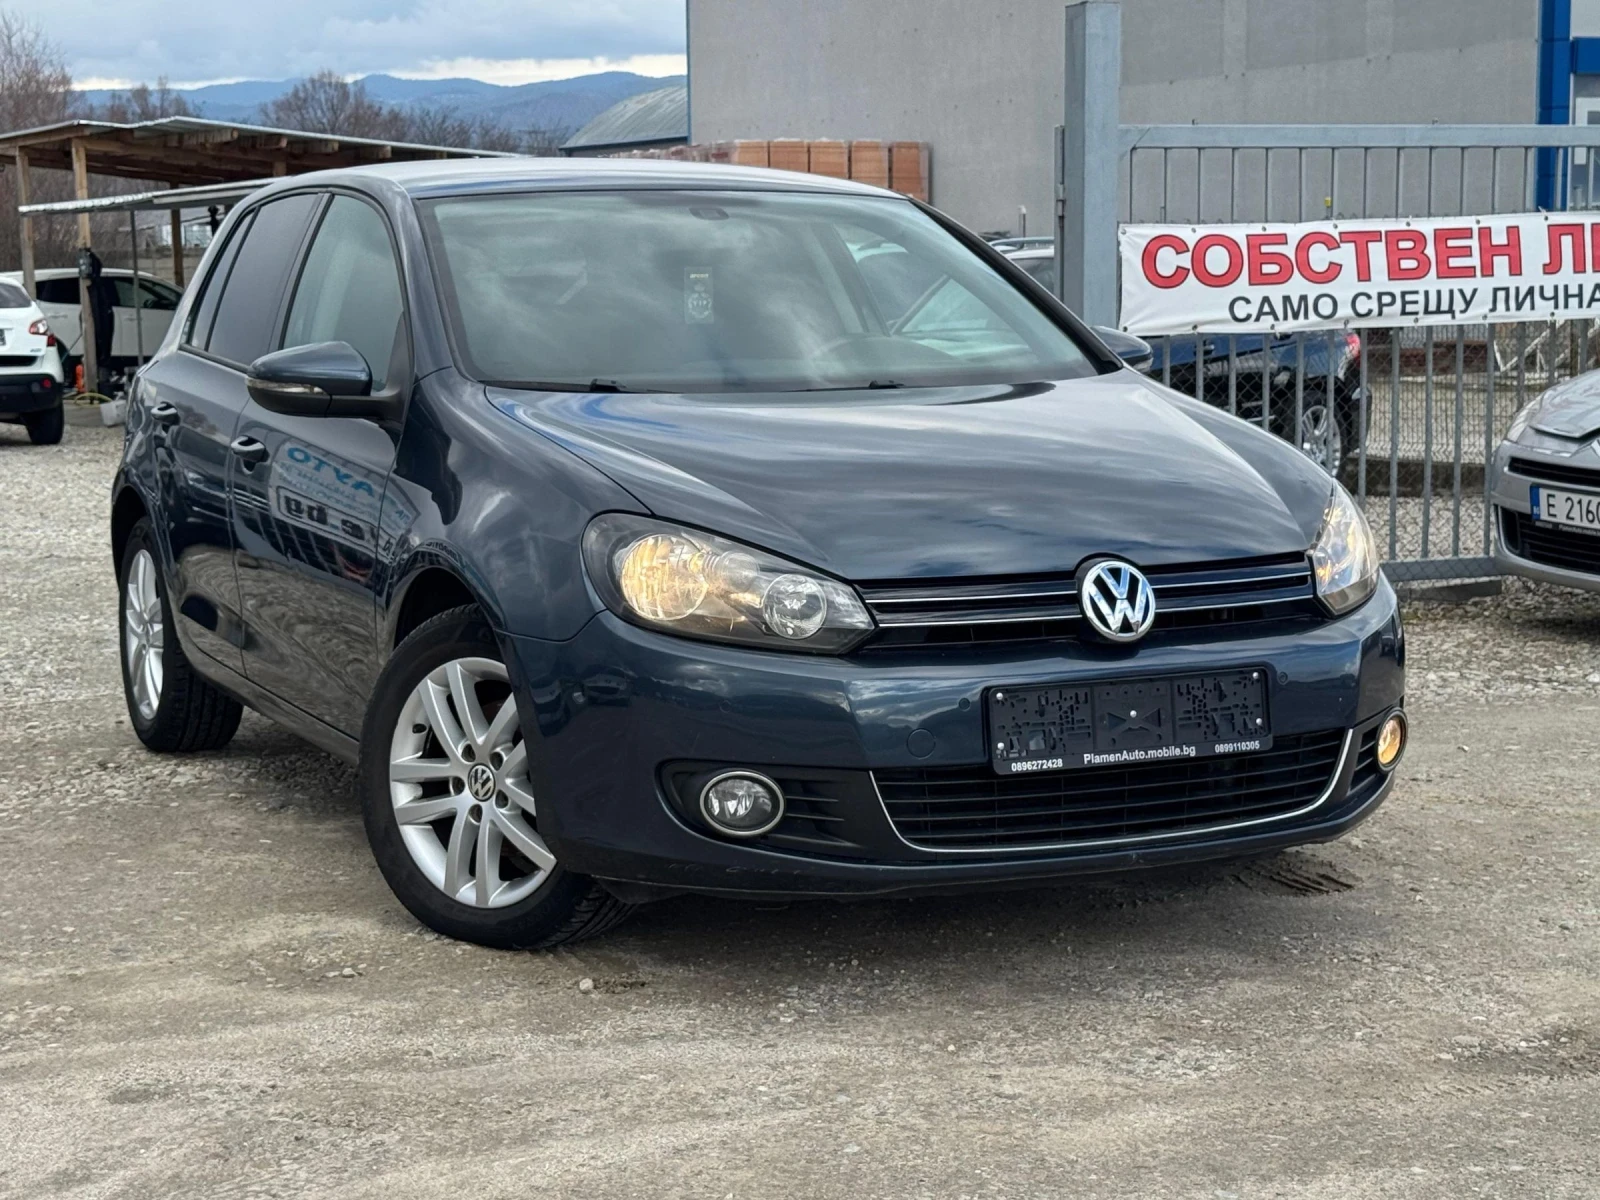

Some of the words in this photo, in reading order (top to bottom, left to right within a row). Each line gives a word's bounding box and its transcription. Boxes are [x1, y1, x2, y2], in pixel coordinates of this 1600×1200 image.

[1141, 225, 1522, 289] СОБСТВЕН
[1542, 222, 1600, 275] Л
[1228, 293, 1338, 323] САМО
[1350, 287, 1478, 320] СРЕЩУ
[1546, 493, 1557, 518] E
[1011, 758, 1063, 772] 0896272428
[1083, 745, 1196, 764] PlamenAuto.mobile.bg
[1214, 740, 1260, 754] 0899110305
